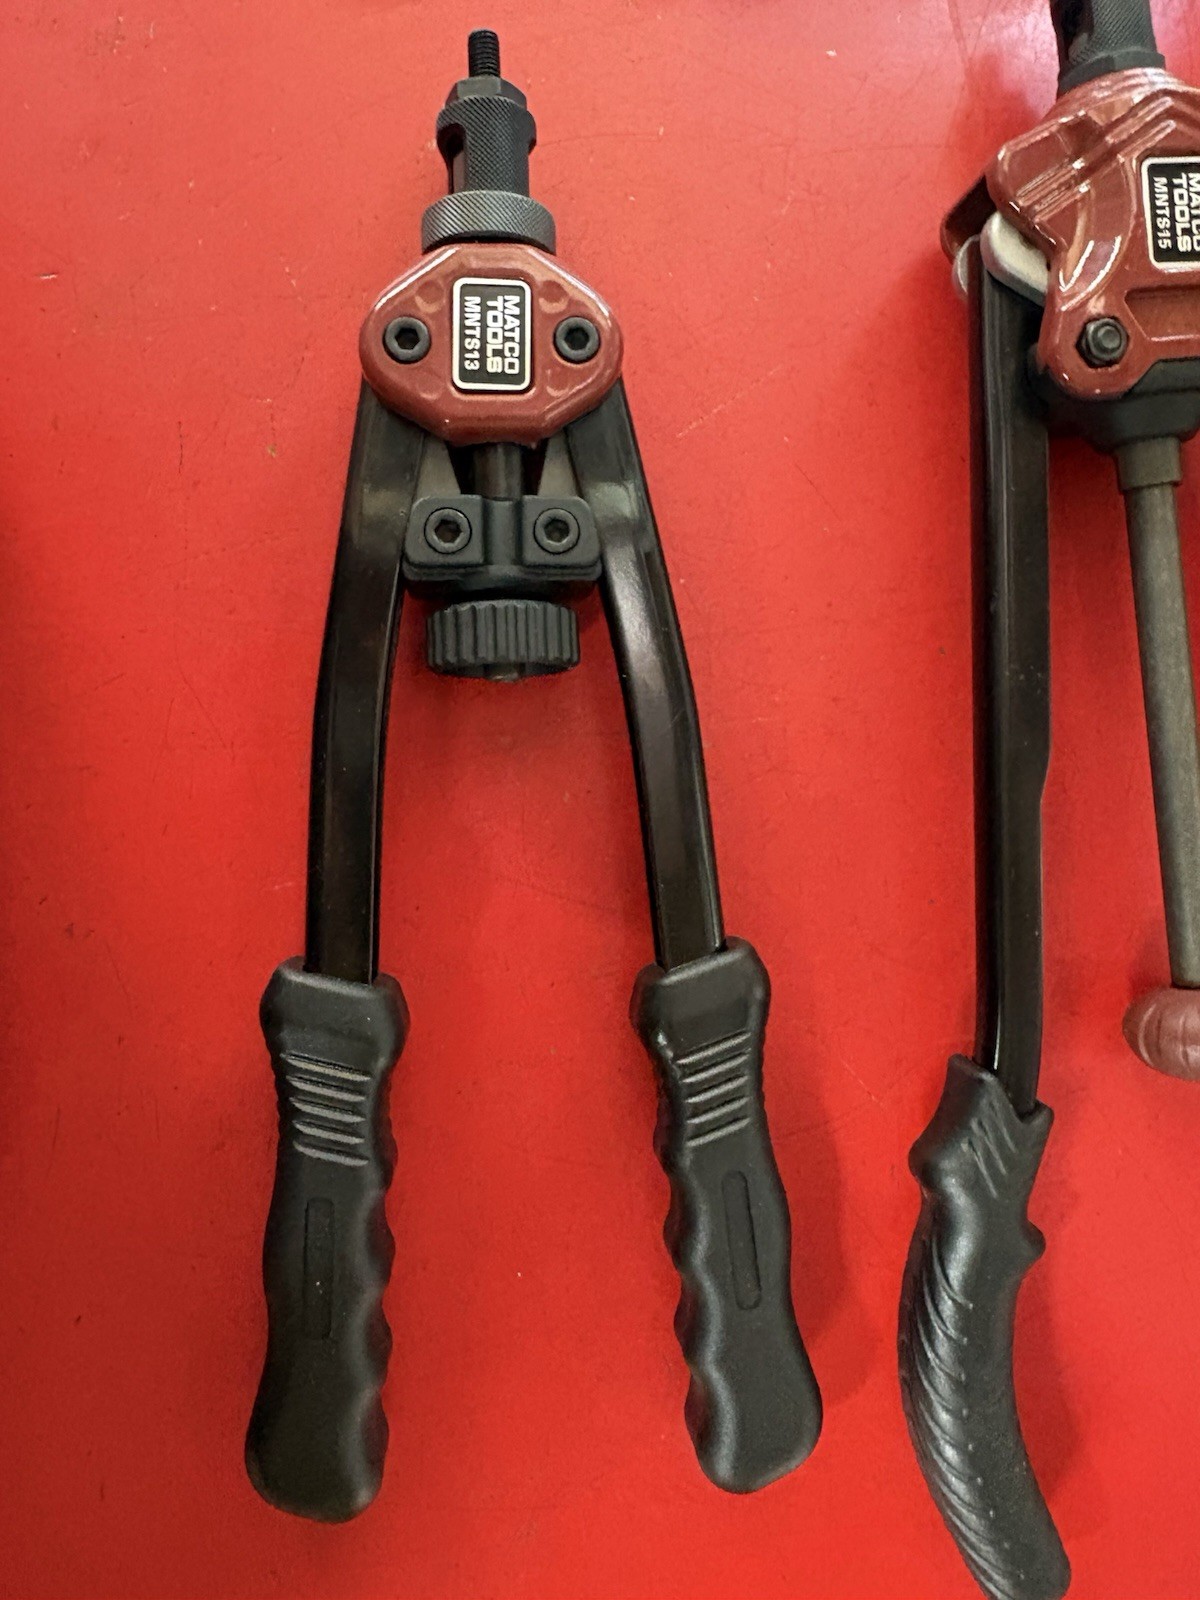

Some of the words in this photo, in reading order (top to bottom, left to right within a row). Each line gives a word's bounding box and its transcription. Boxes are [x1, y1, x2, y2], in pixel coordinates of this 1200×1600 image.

[1153, 176, 1172, 249] MNTS15
[1172, 172, 1192, 252] TOOLS
[463, 296, 481, 371] MNTS13
[486, 295, 504, 373] TOOLS
[503, 295, 521, 375] MATCO
